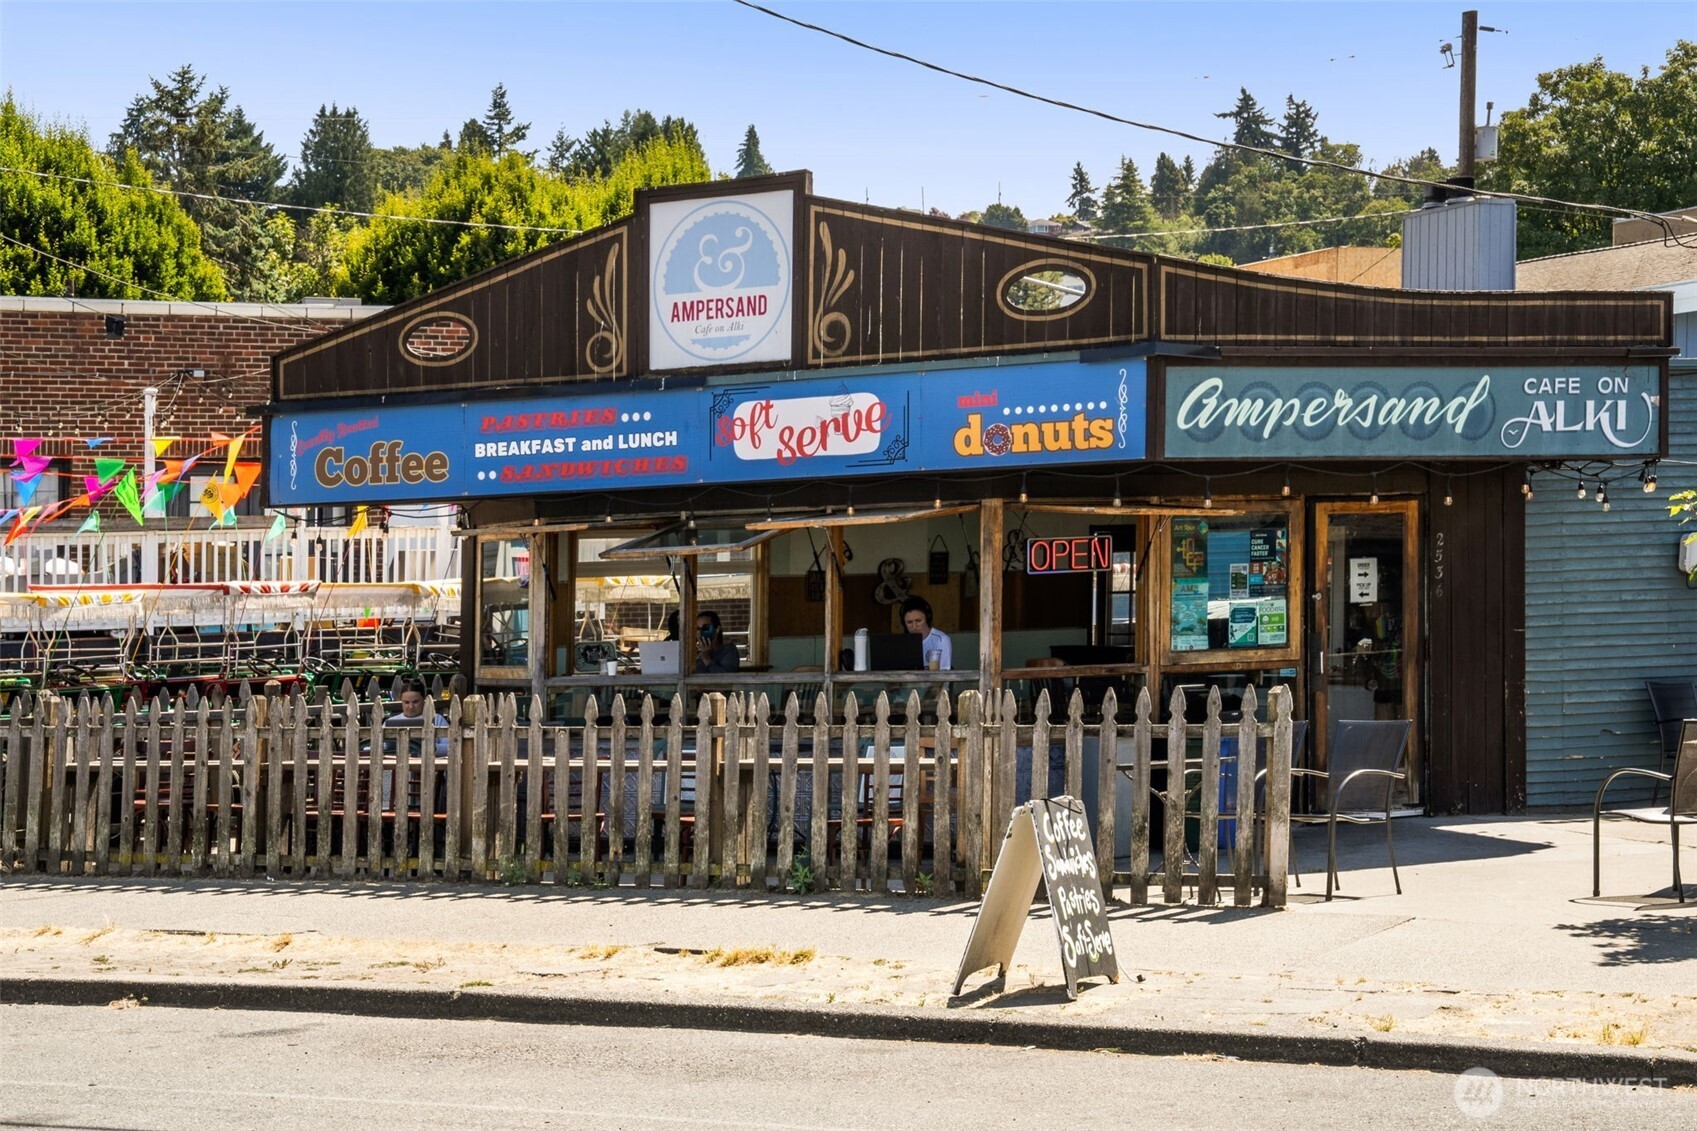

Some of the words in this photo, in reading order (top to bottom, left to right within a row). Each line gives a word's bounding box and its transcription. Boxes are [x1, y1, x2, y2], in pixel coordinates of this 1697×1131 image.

[671, 294, 767, 323] AMPERSAND
[727, 321, 744, 332] Alki
[957, 389, 998, 409] mini
[1523, 377, 1580, 394] CAFE
[1597, 376, 1629, 394] ON
[480, 407, 617, 435] PASTRIES
[716, 398, 779, 450] soft
[777, 401, 893, 466] serve
[953, 411, 1115, 457] donuts
[1500, 392, 1653, 448] ALKI
[474, 437, 576, 458] BREAKFAST
[581, 435, 613, 452] and
[618, 431, 678, 449] LUNCH
[314, 440, 450, 489] Coffee
[501, 454, 688, 483] SANDWICHES
[1030, 538, 1109, 571] OPEN
[1043, 808, 1086, 843] Coffee
[1057, 886, 1100, 920] Pastries
